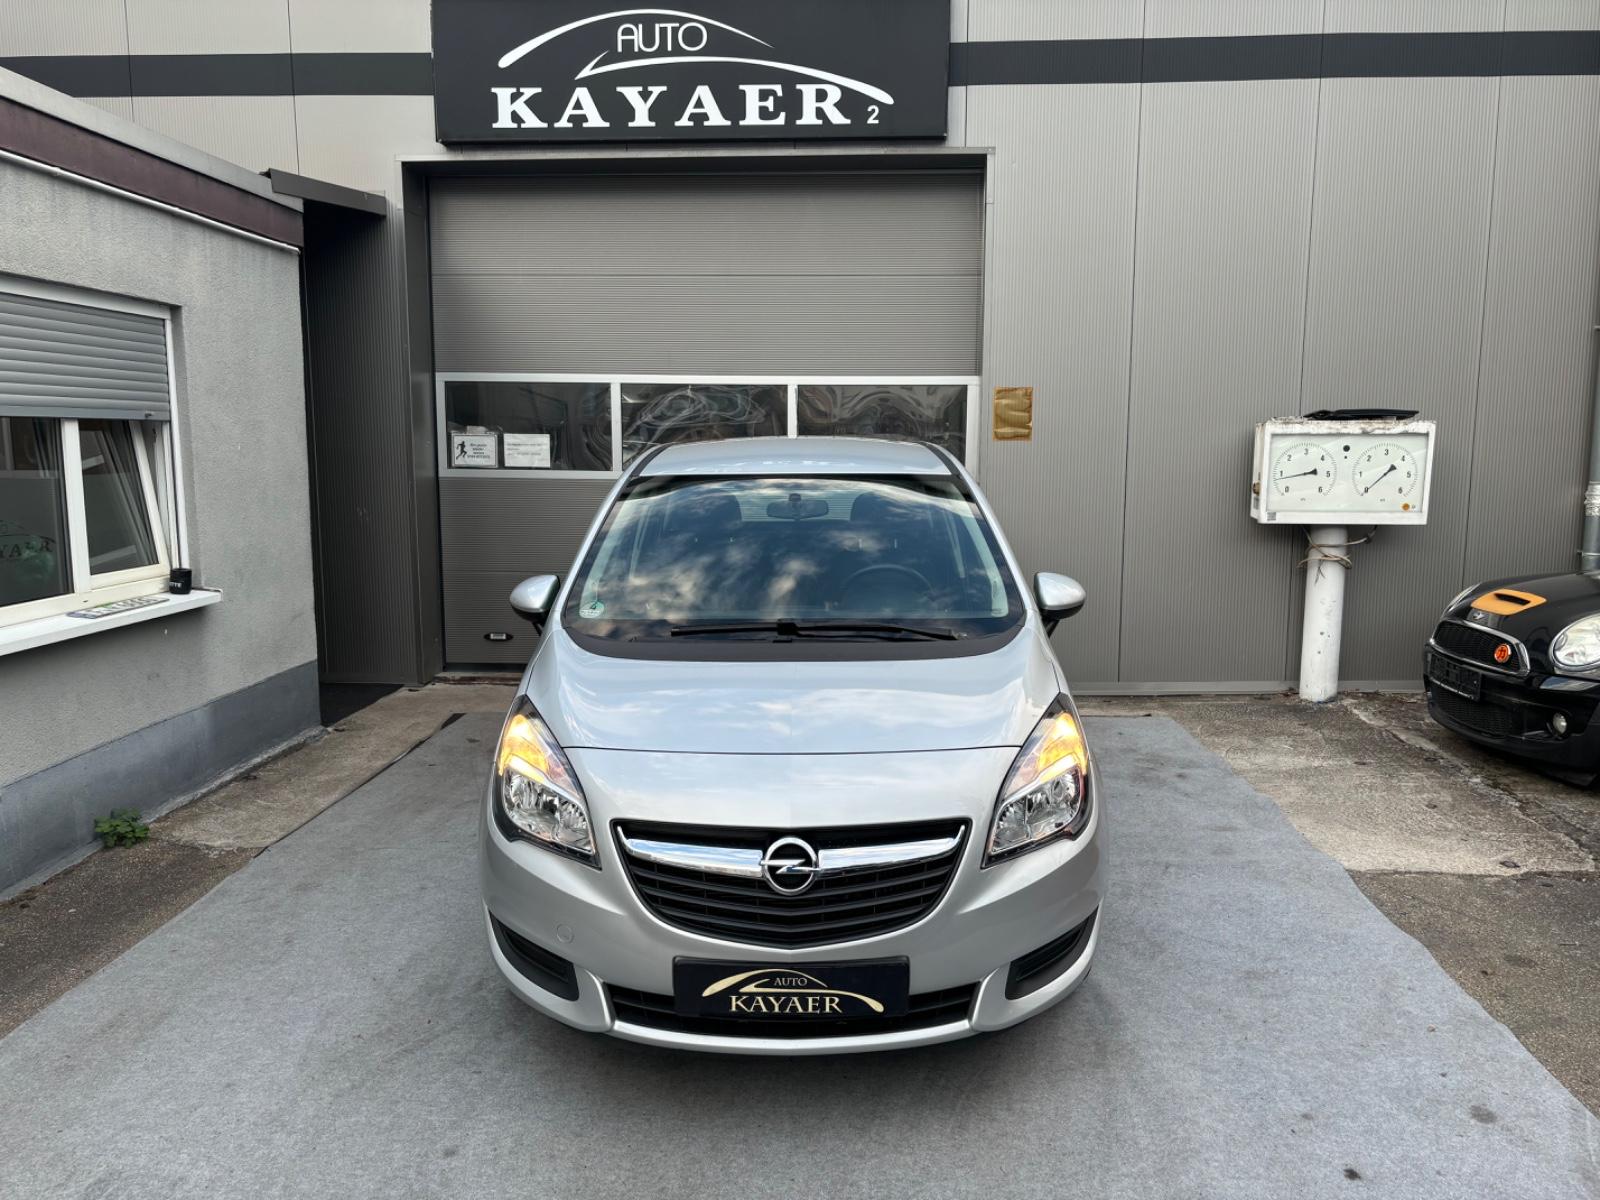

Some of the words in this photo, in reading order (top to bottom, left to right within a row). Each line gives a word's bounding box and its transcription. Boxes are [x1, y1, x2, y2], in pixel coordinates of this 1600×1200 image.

[617, 22, 708, 53] AUTO
[490, 83, 852, 129] KAYAER
[866, 105, 880, 125] 2
[774, 977, 808, 986] AUTO
[728, 995, 843, 1014] KAYAER
